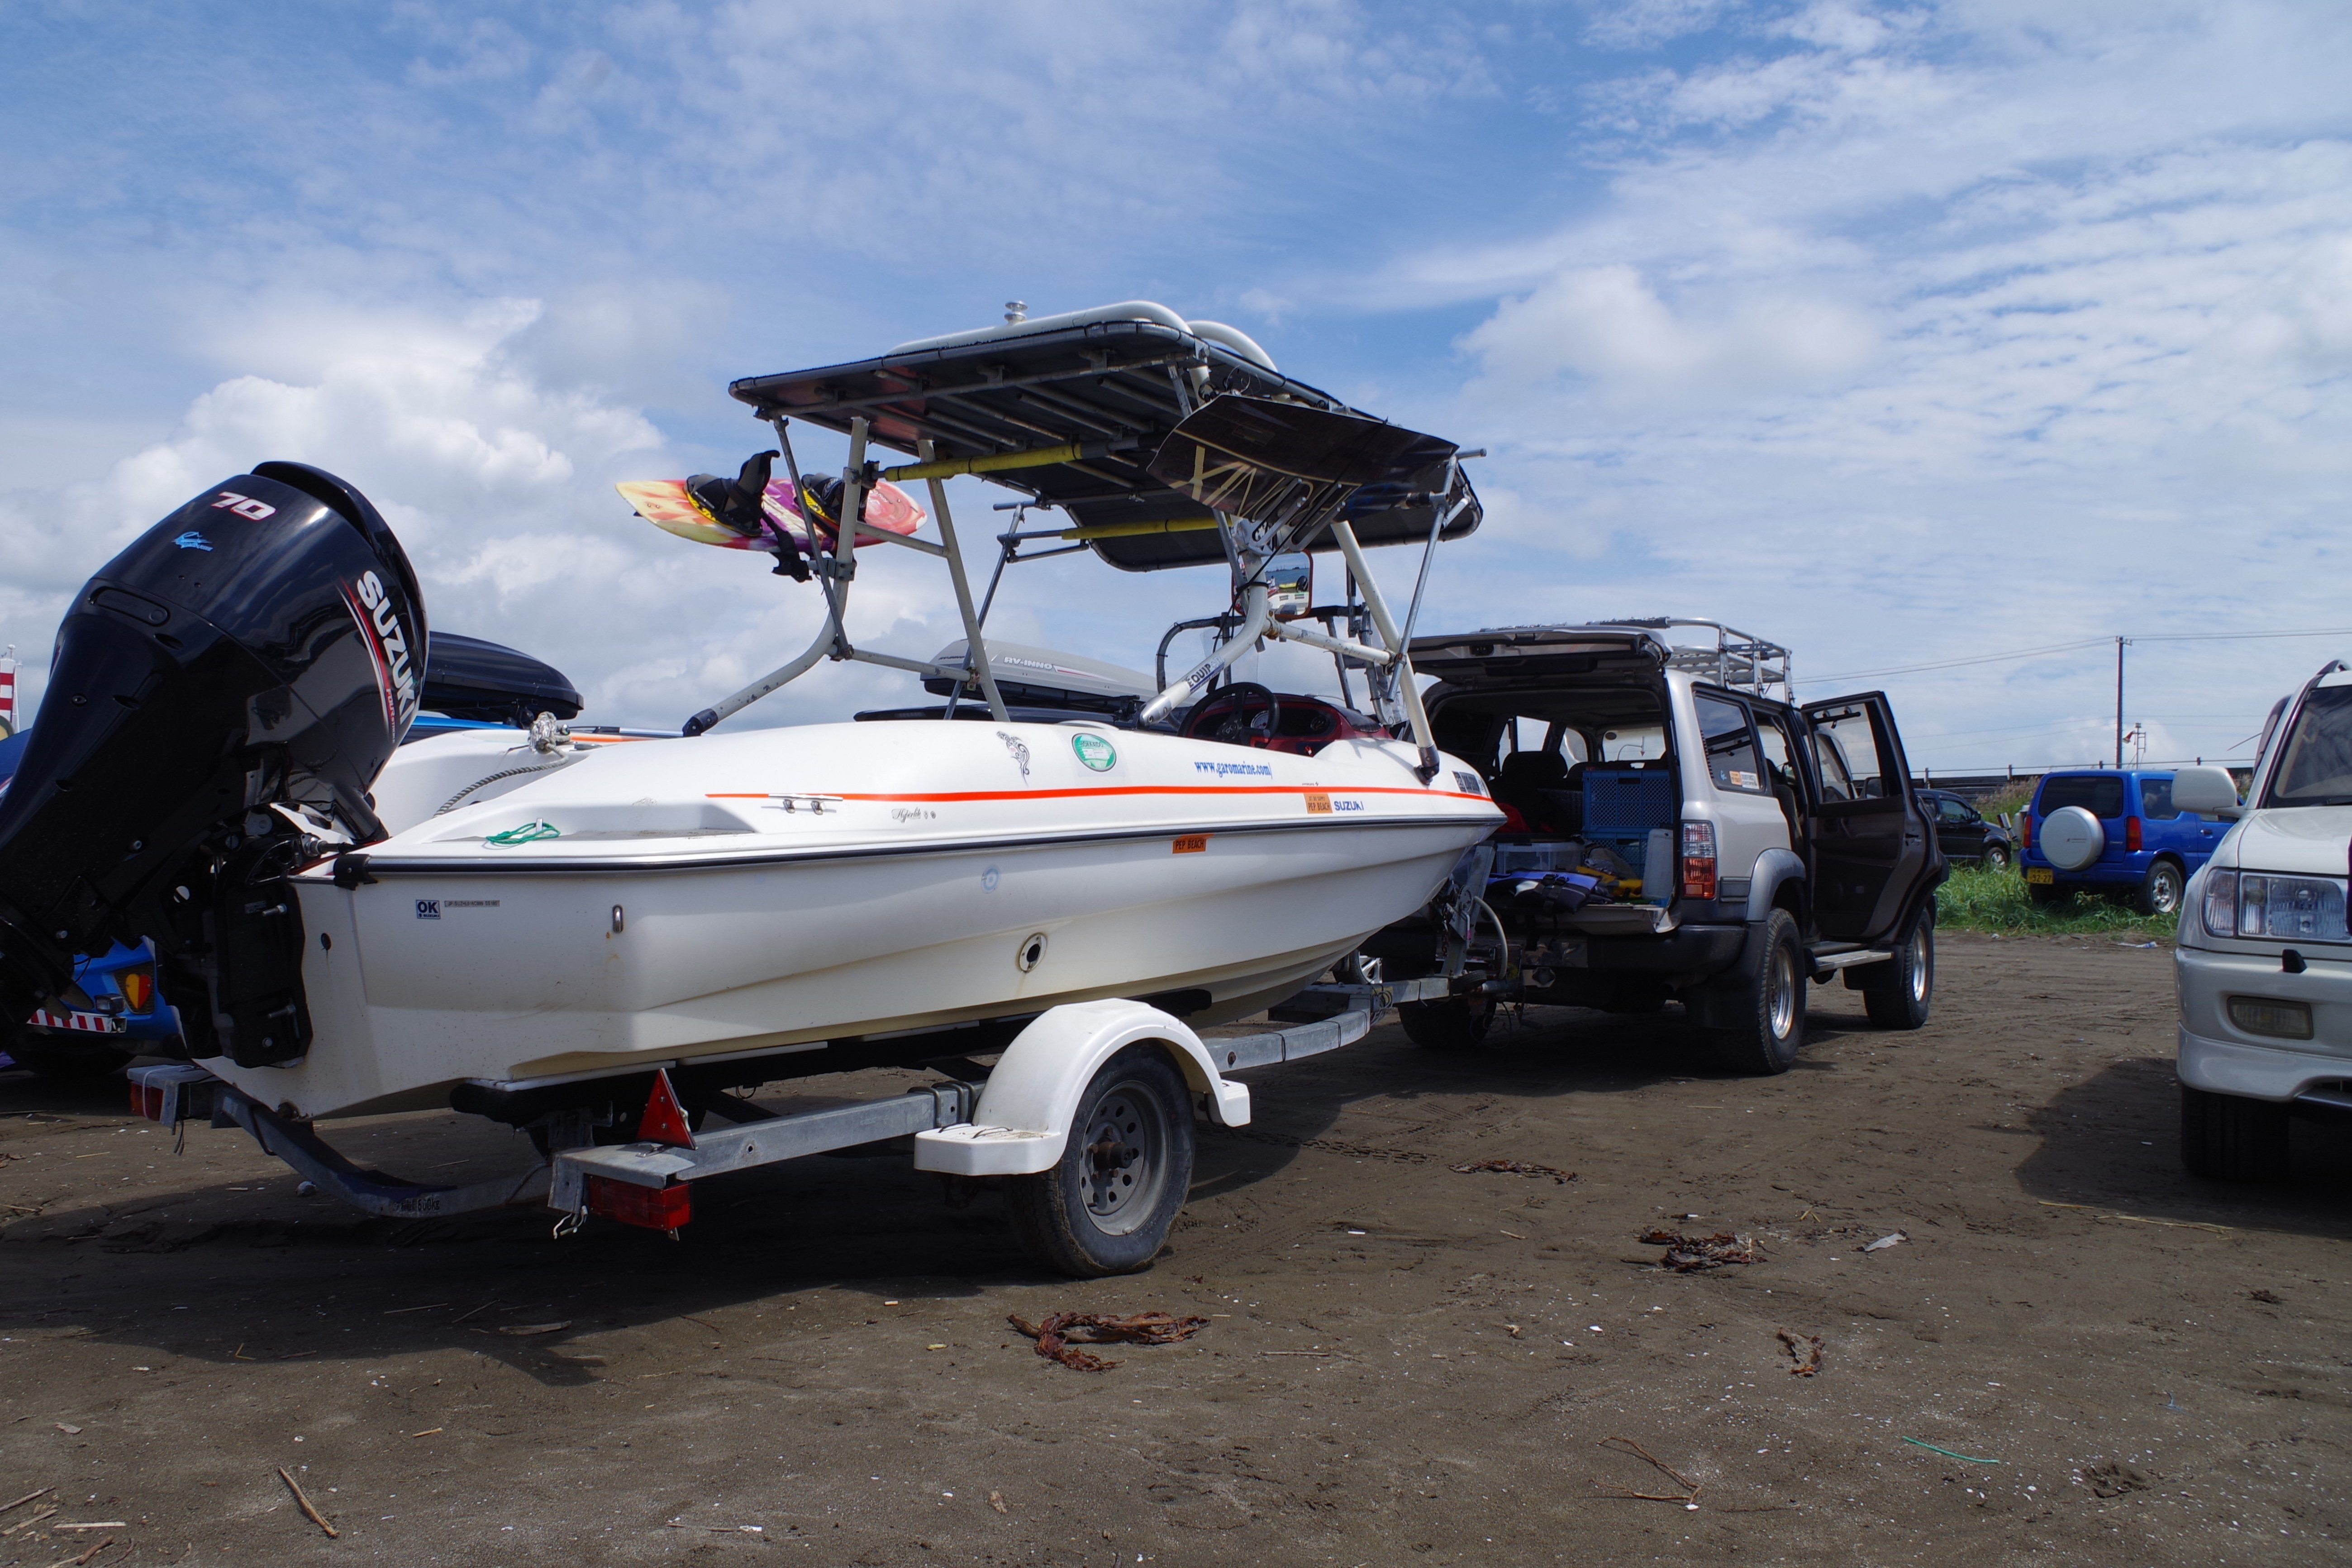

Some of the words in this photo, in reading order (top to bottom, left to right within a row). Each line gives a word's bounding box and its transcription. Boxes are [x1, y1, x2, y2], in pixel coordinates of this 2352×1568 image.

[210, 491, 276, 520] 70
[357, 570, 415, 725] SUZUKI
[1004, 657, 1053, 670] RV-INNO
[1334, 801, 1364, 811] SUZUKI
[1176, 841, 1186, 850] PEP
[1187, 839, 1204, 849] BEACH
[418, 901, 438, 913] OK
